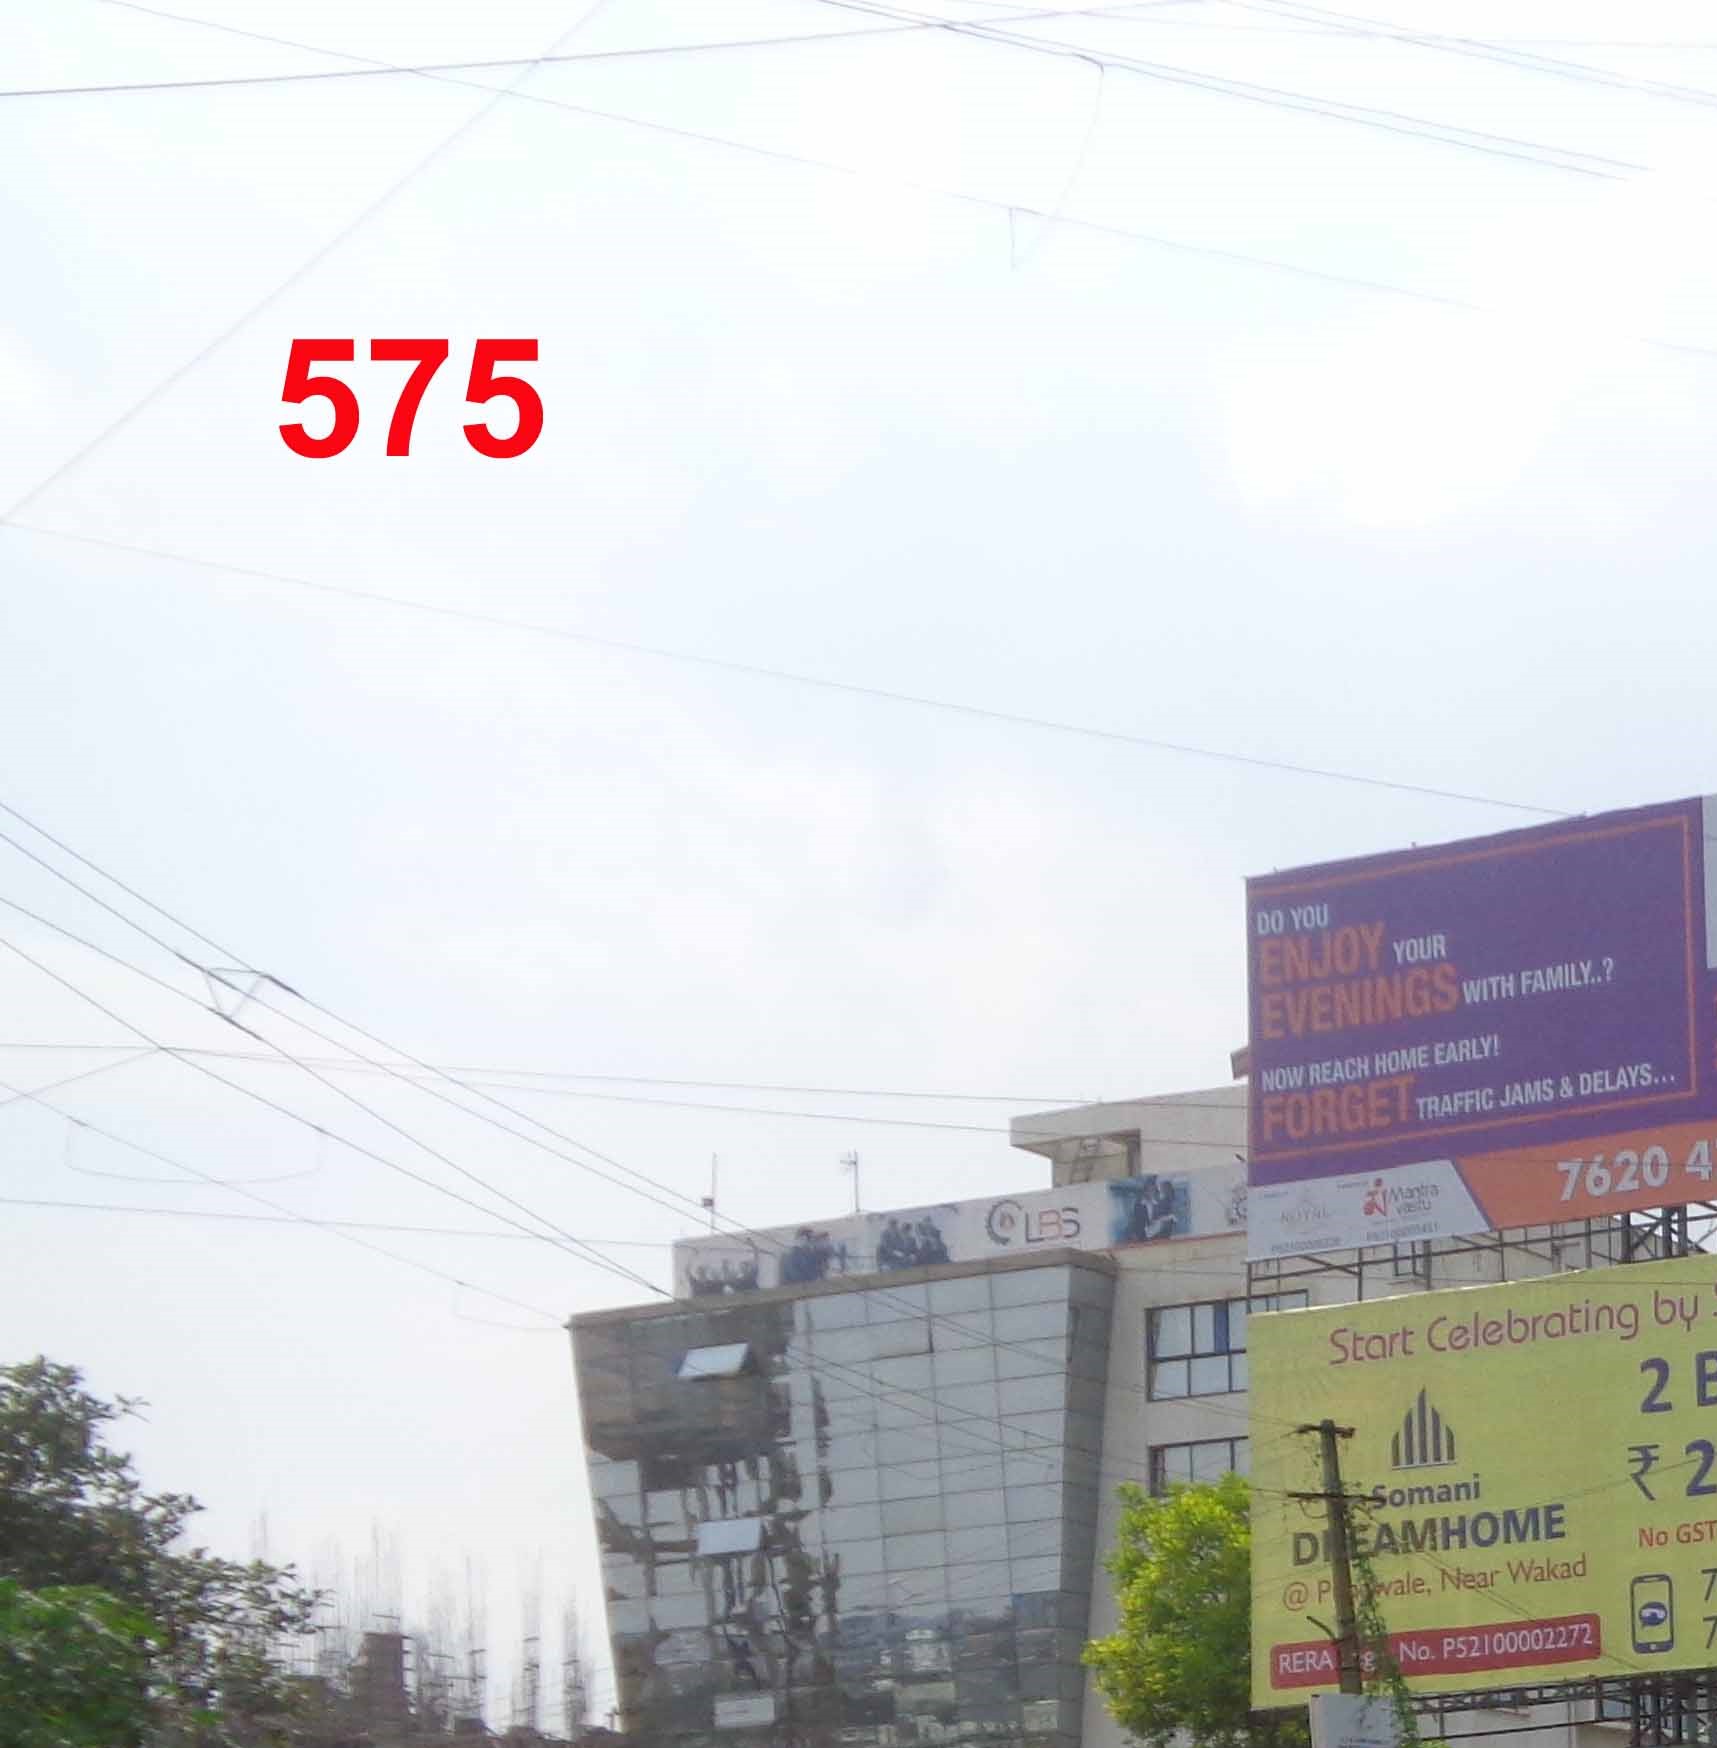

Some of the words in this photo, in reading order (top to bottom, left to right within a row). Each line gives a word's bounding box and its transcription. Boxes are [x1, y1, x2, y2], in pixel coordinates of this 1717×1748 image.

[1256, 909, 1285, 935] DO
[1290, 903, 1329, 930] YOU
[1259, 920, 1384, 986] ENJOY
[1393, 933, 1447, 965] YOUR
[1260, 962, 1460, 1041] EVENINGS
[1462, 973, 1515, 1005] WITH
[1261, 1065, 1304, 1092] NOW
[1309, 1056, 1369, 1087] REACH
[1375, 1045, 1430, 1076] HOME
[1262, 1073, 1416, 1142] FORGET
[1415, 1086, 1494, 1121] TRAFFIC
[1500, 1075, 1554, 1107] JAMS
[1557, 1145, 1670, 1201] 7620
[1329, 1325, 1415, 1366] Start
[1426, 1299, 1639, 1353] Celebrating
[1652, 1288, 1699, 1332] by
[1640, 1356, 1673, 1414] 2
[1371, 1472, 1481, 1511] Somani
[1638, 1526, 1669, 1548] No
[1675, 1519, 1717, 1545] GST
[1441, 1567, 1501, 1591] Near
[1507, 1552, 1588, 1584] Wakad
[1279, 1651, 1335, 1675] RERA
[1399, 1641, 1436, 1663] No.
[1443, 1622, 1594, 1659] P52100002272
